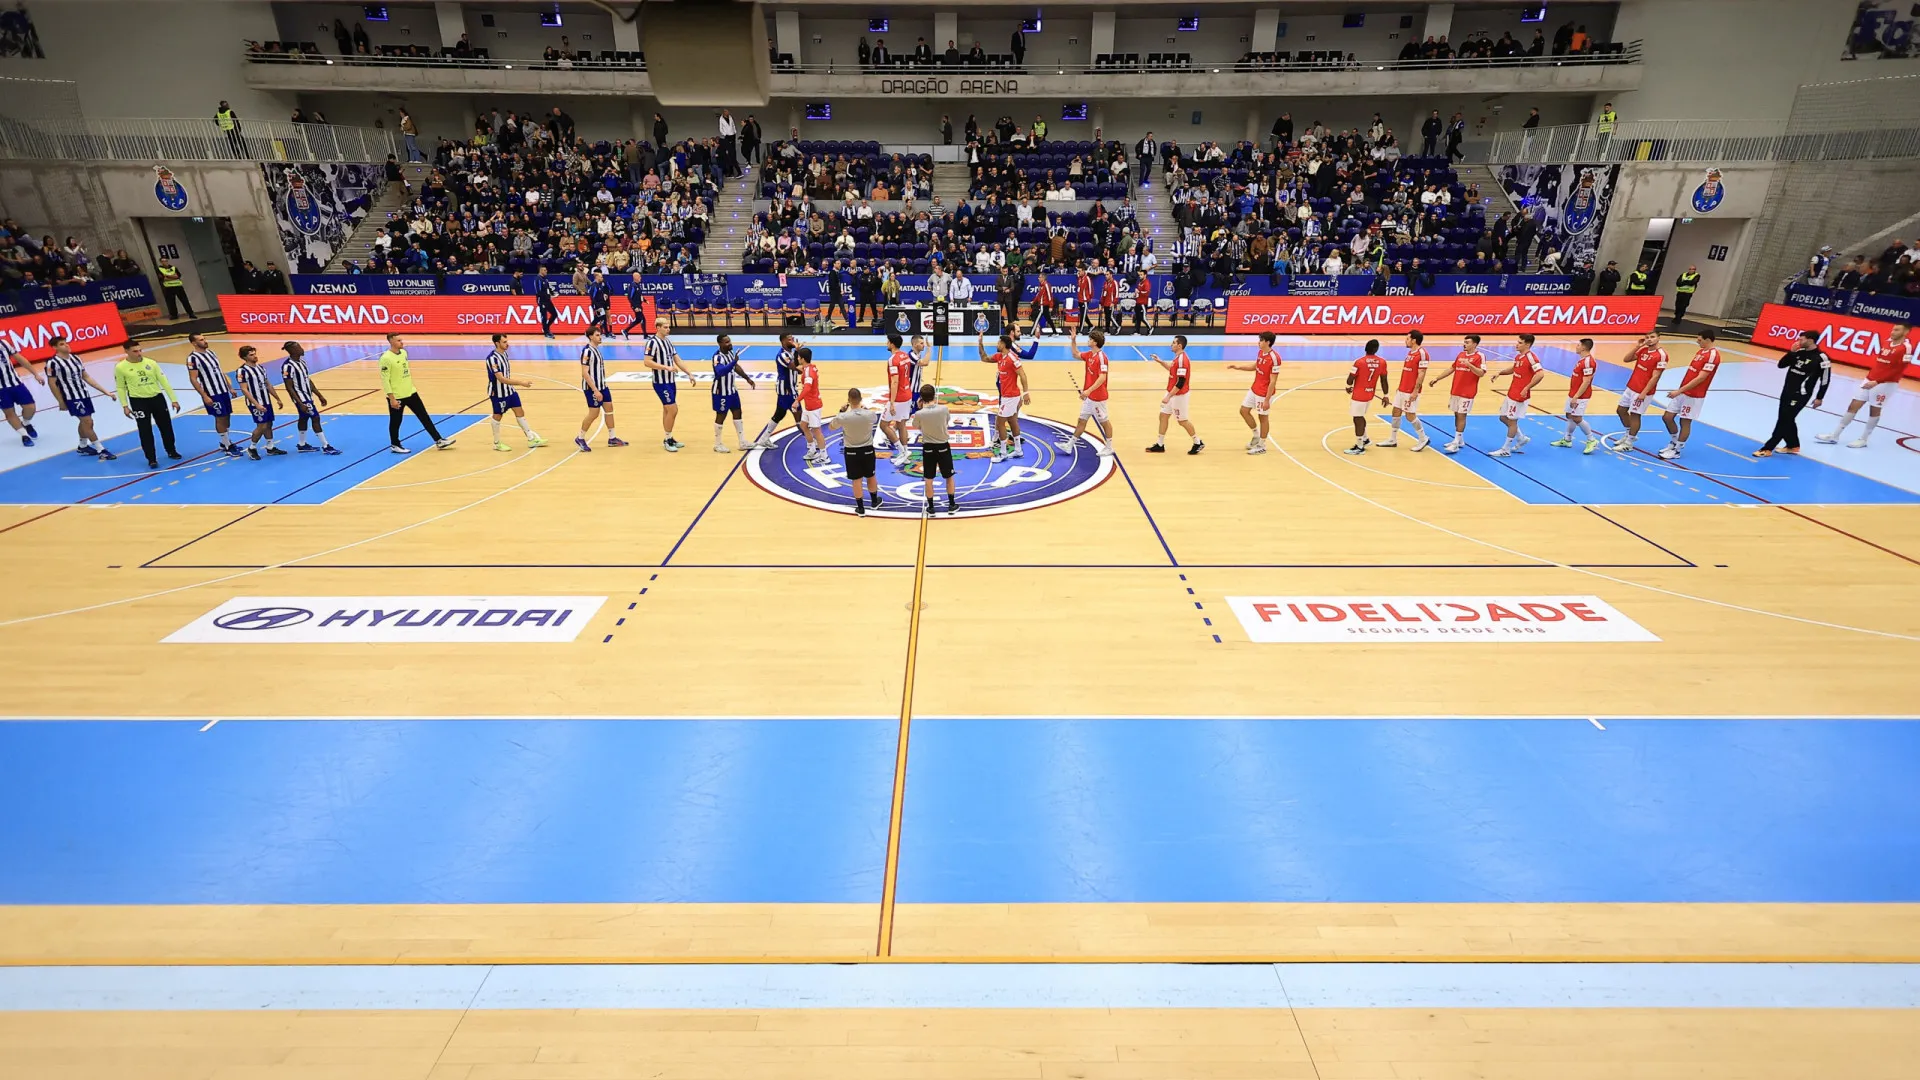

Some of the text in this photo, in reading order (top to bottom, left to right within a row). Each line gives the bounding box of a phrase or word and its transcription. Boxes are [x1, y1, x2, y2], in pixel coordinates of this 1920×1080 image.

[881, 77, 1019, 94] DRAGÃO ARENA
[310, 283, 357, 294] AZEMAD
[387, 279, 435, 287] BUY ONLINE
[818, 280, 853, 293] Vilis
[1026, 284, 1077, 294] Grnvolt
[1455, 279, 1489, 294] Vitalis
[1525, 283, 1571, 291] FIDELIDAD
[1790, 293, 1843, 308] FIDELIDAE
[240, 304, 425, 325] SPORT.AZEMAD.COM
[1242, 305, 1425, 326] SPORT.AZEMAD.COM
[1455, 305, 1641, 326] SPORT.AZEMAD.COM
[1367, 368, 1376, 382] 7
[720, 398, 727, 406] 2
[1681, 405, 1691, 414] 28
[317, 608, 574, 628] HYUNDAI
[1252, 602, 1609, 623] FIDELIDADE
[1346, 627, 1430, 635] SEGUROS
[1437, 627, 1495, 635] DESDE
